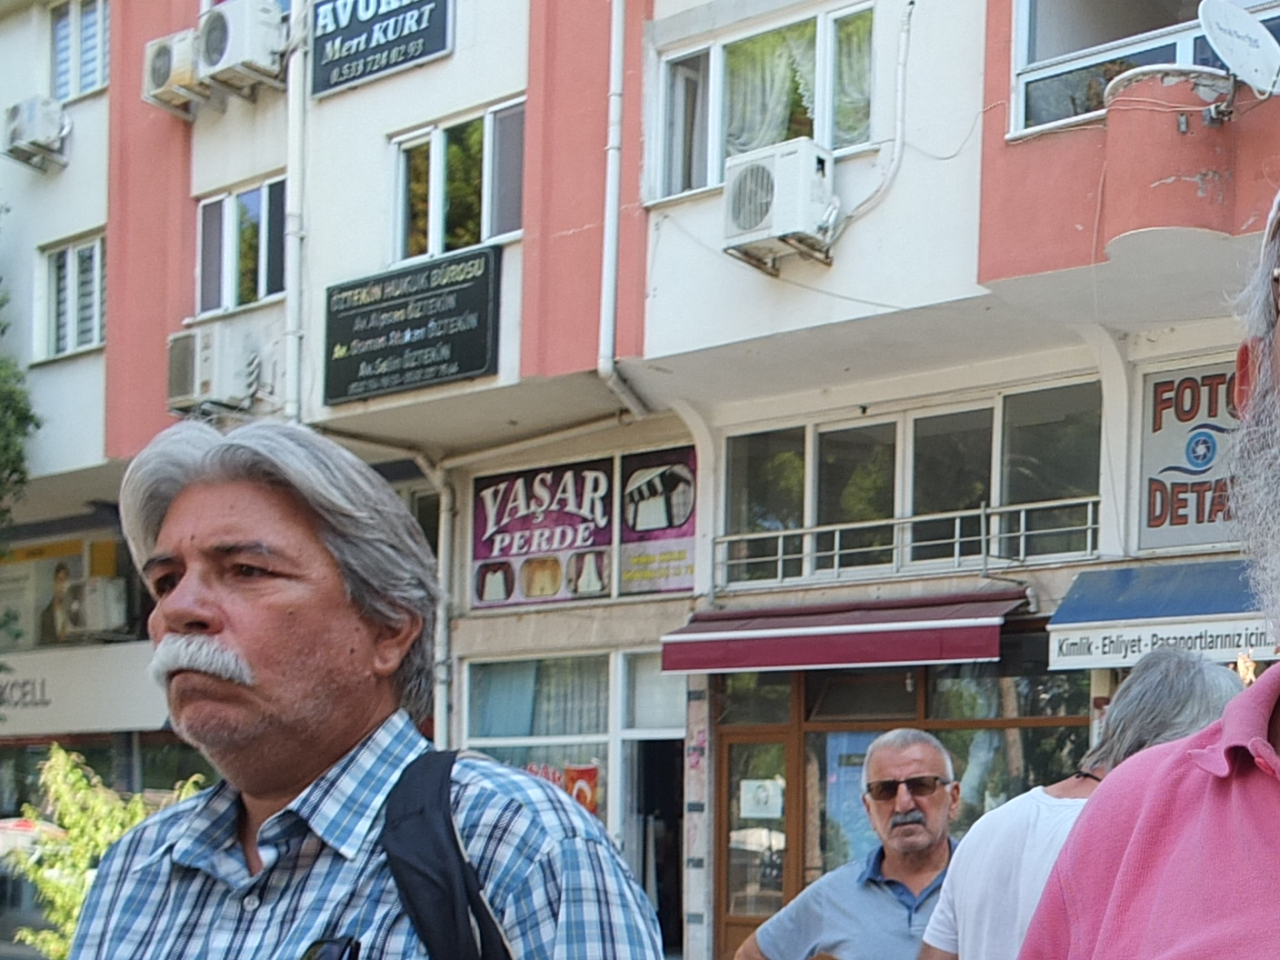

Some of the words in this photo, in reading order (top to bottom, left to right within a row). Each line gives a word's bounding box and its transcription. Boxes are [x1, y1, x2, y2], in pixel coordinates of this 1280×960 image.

[321, 32, 368, 65] Mert
[369, 3, 436, 49] KURT
[479, 470, 609, 542] YAŞAR
[490, 523, 596, 557] PERDE
[1057, 636, 1094, 658] Kimlik
[1101, 634, 1142, 660] Ehliyet
